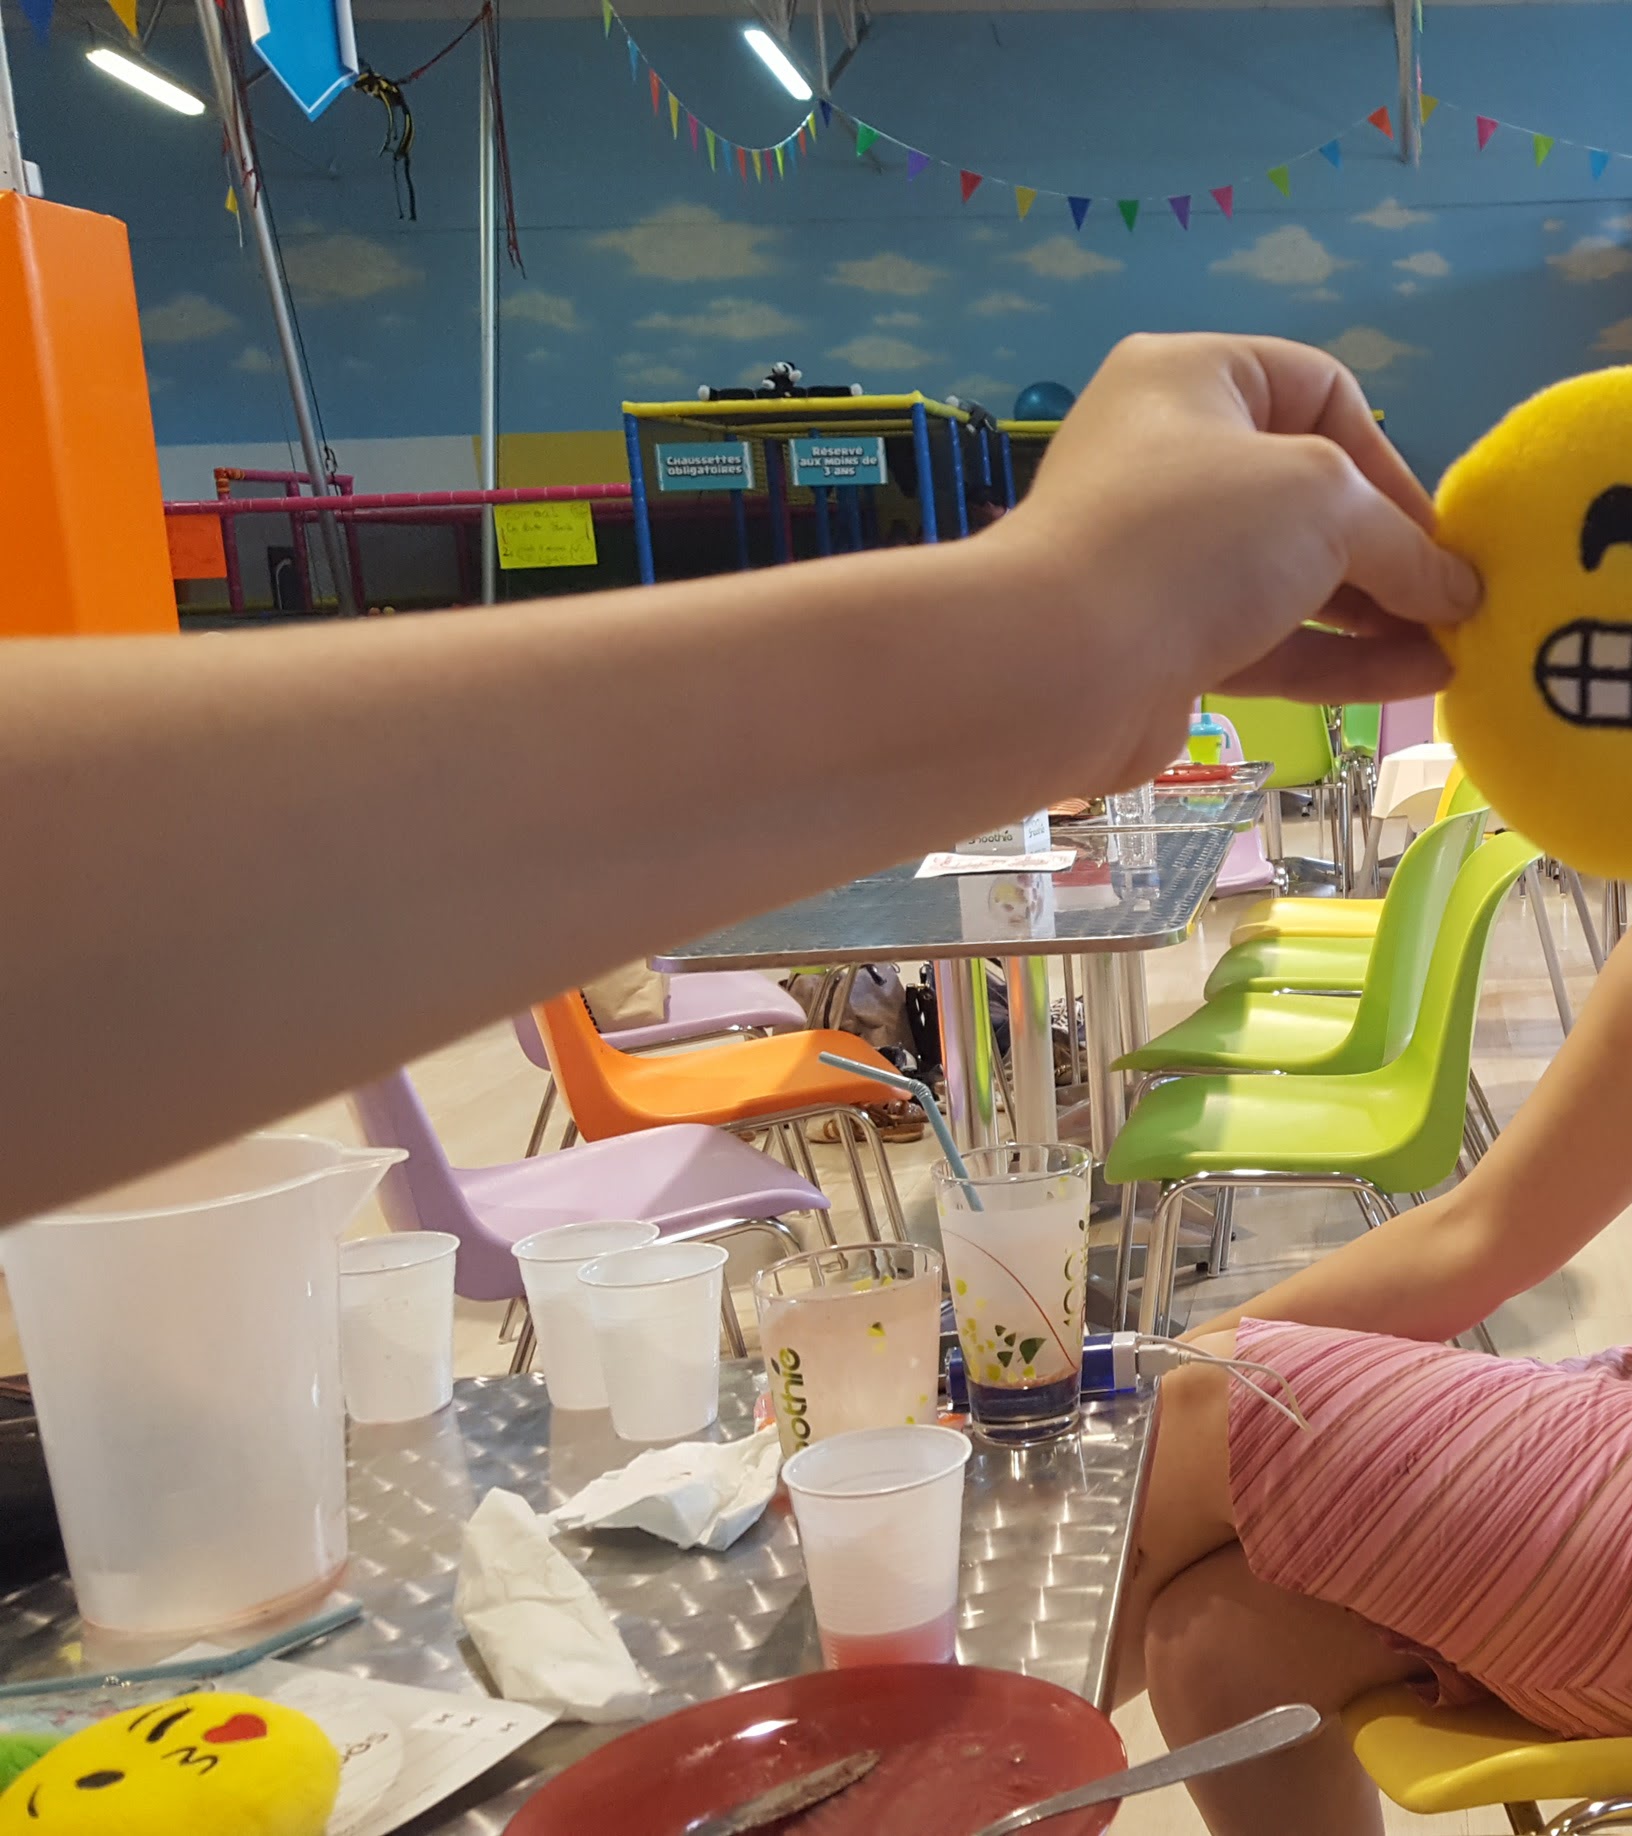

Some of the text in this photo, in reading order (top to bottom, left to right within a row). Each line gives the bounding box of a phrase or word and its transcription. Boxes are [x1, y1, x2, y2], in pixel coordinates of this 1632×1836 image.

[800, 457, 821, 467] aux
[862, 455, 877, 465] de
[824, 466, 831, 476] 3
